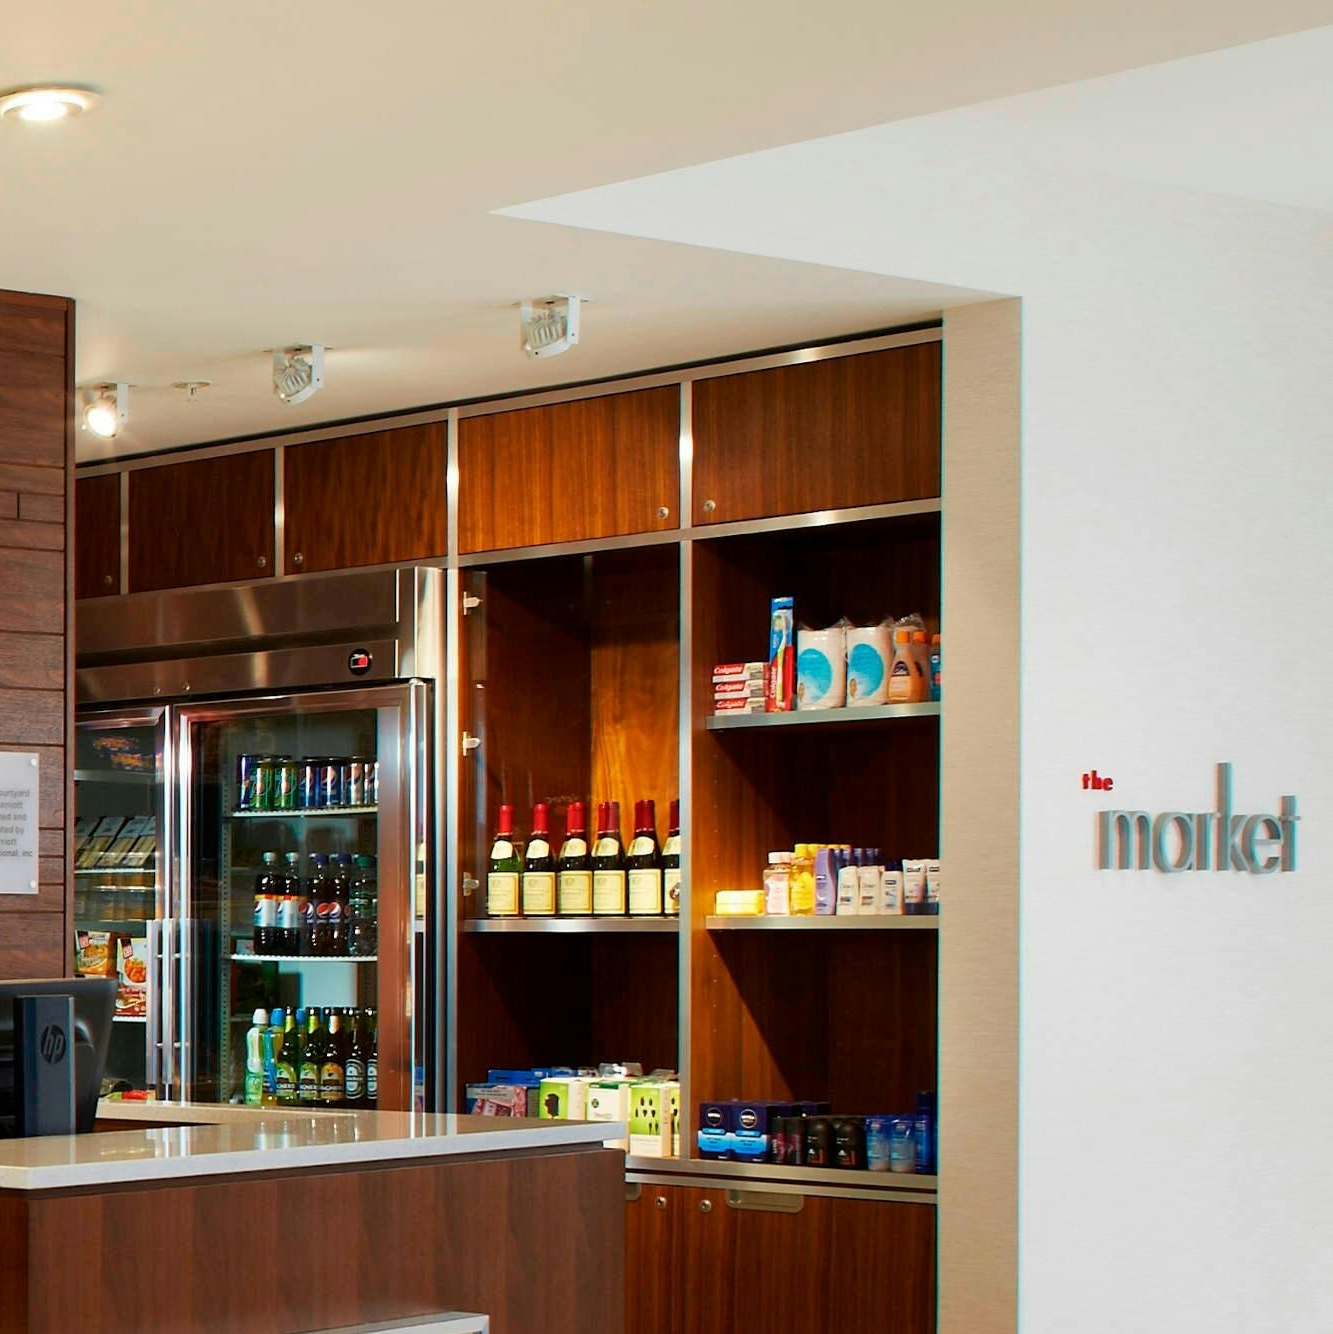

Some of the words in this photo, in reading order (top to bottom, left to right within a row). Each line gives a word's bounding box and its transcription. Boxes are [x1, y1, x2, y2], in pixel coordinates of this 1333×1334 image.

[714, 665, 743, 674] Colgate
[716, 683, 744, 691] Colgate
[717, 700, 744, 708] Colgate
[1080, 769, 1114, 791] the
[1095, 762, 1301, 875] market
[15, 826, 25, 835] by
[42, 1025, 66, 1064] hp
